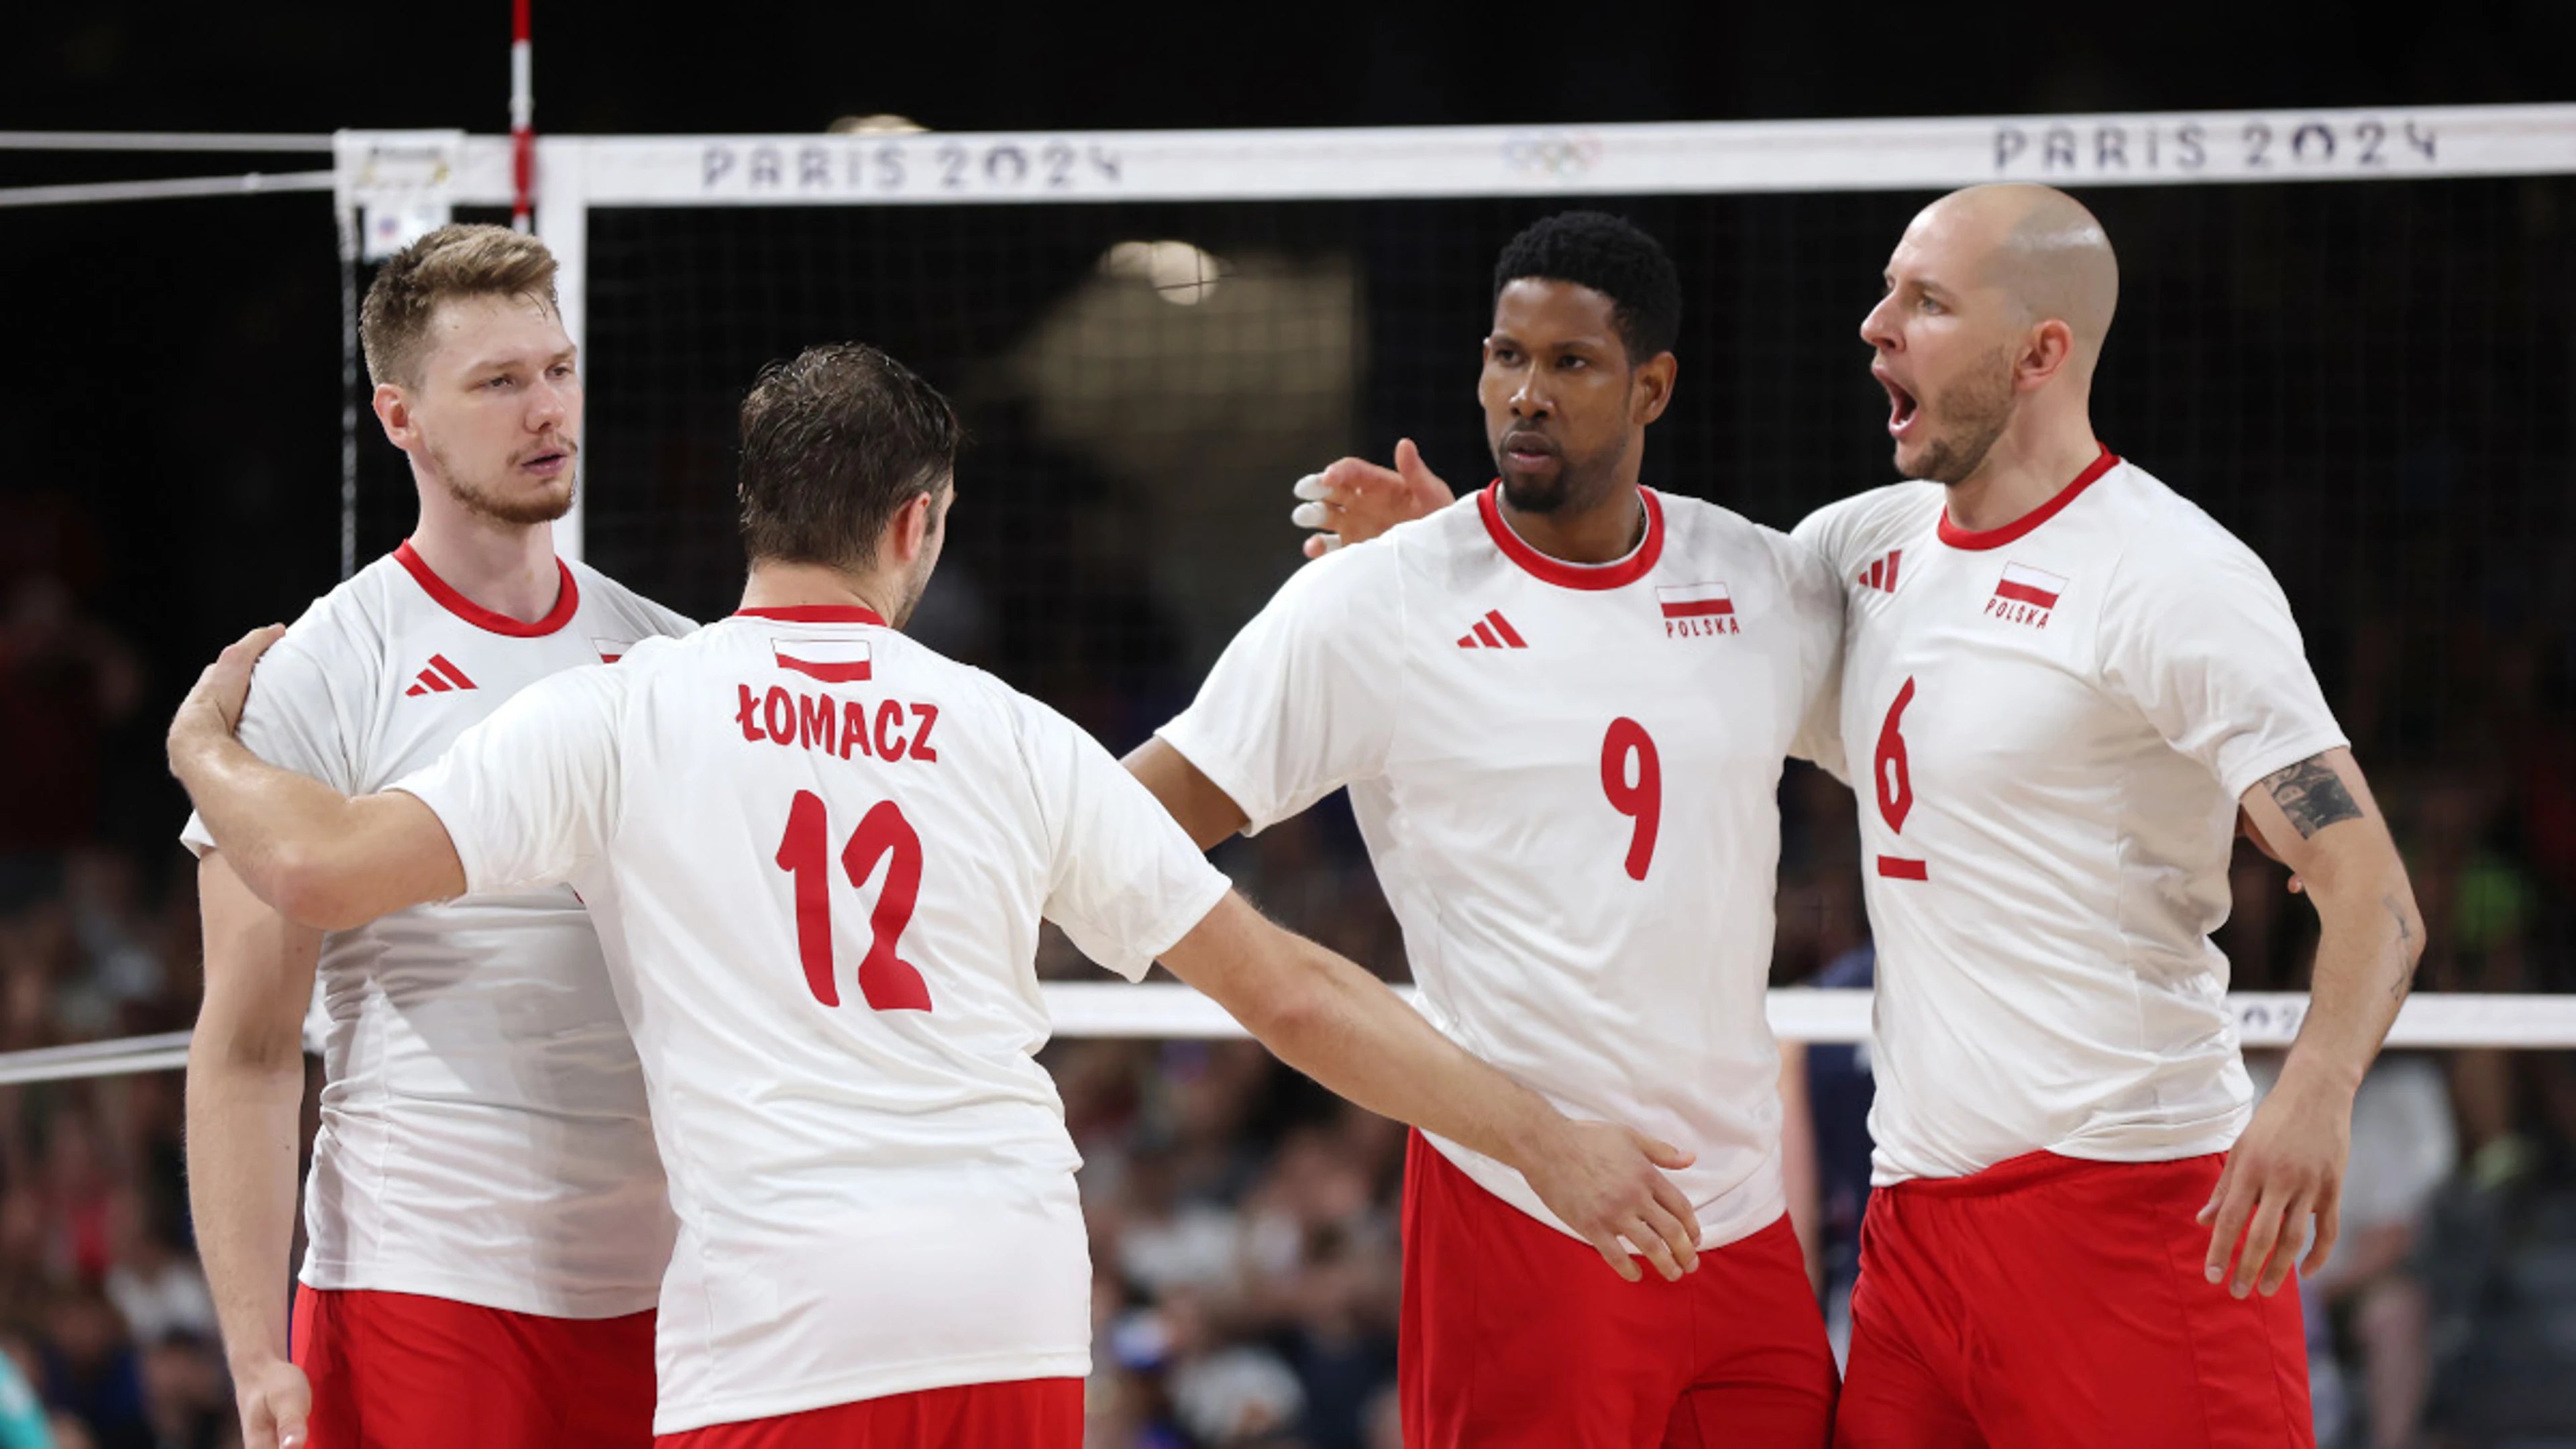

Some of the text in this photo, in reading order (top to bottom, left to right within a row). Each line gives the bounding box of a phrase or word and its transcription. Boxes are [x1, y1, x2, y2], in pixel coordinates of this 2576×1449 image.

[701, 143, 1122, 189] PARIS 2024
[1991, 119, 2438, 170] PARIS 2024
[1665, 616, 1740, 638] POLSKA
[1984, 598, 2049, 629] POLSKA
[736, 684, 939, 763] ŁOMACZ
[1875, 675, 1915, 835] 6
[1601, 716, 1662, 881] 9
[775, 789, 932, 1012] 12
